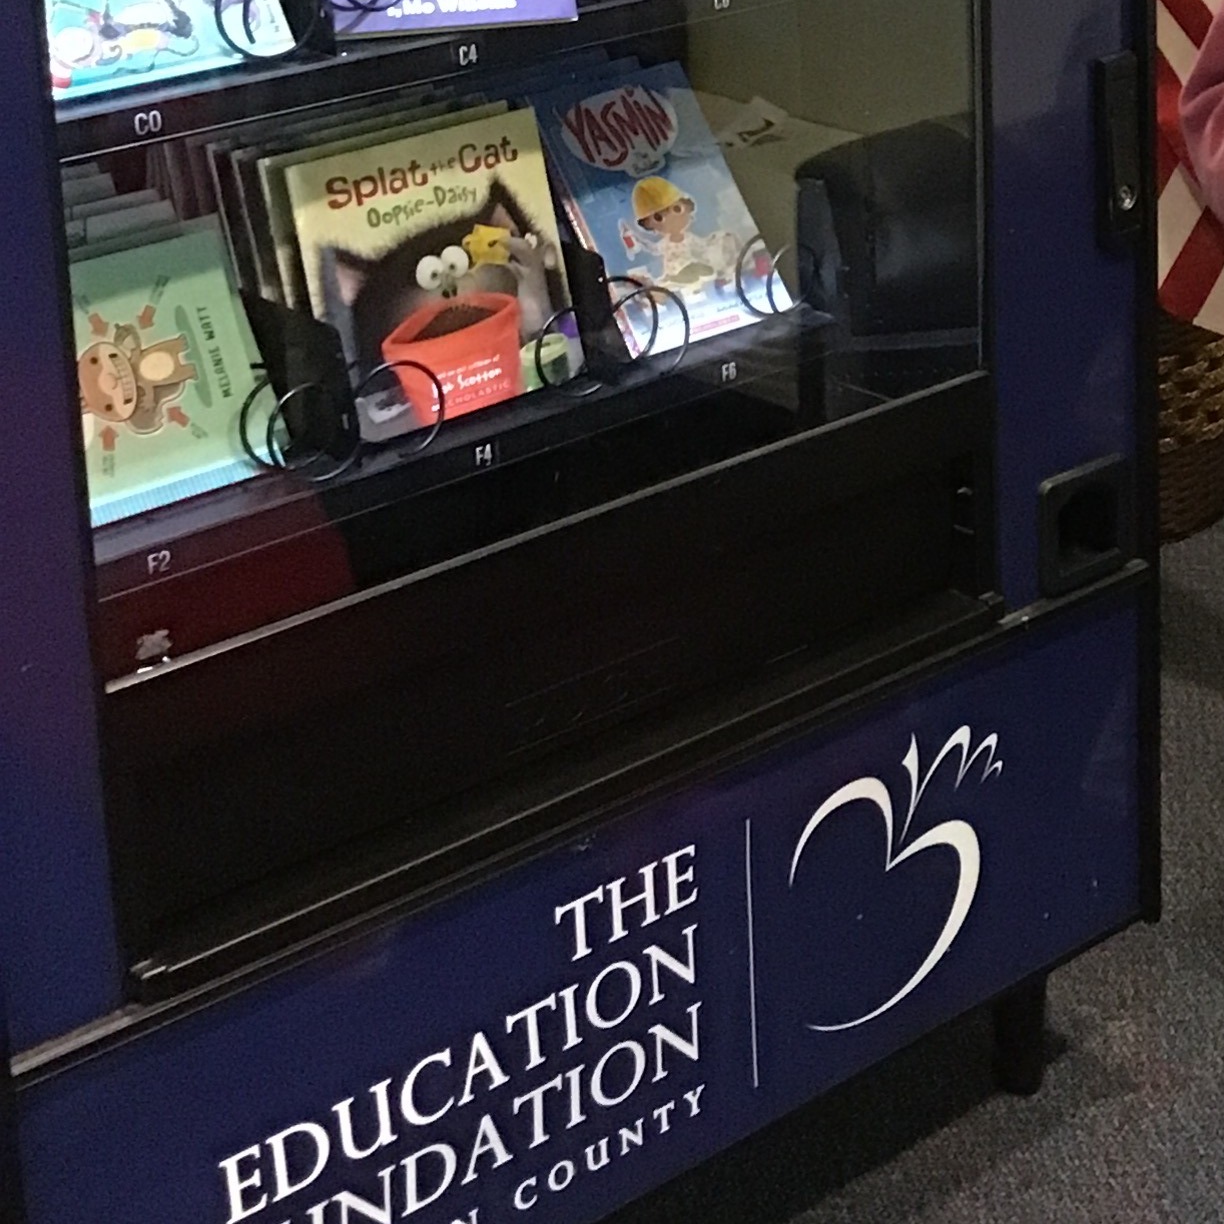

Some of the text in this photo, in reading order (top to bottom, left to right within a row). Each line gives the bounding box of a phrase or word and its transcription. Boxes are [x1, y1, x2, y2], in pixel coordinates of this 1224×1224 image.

[458, 43, 478, 66] C4
[325, 136, 519, 211] Splat the Cat
[366, 184, 478, 229] Oopsie-Daisy
[195, 305, 233, 399] MELANIE WATT
[721, 361, 737, 382] F6
[446, 378, 511, 407] CHOLASTIC
[474, 443, 493, 467] F4
[147, 550, 171, 575] F2
[554, 844, 699, 963] THE
[217, 925, 699, 1224] EDUCATION
[512, 1084, 705, 1211] COUNTY
